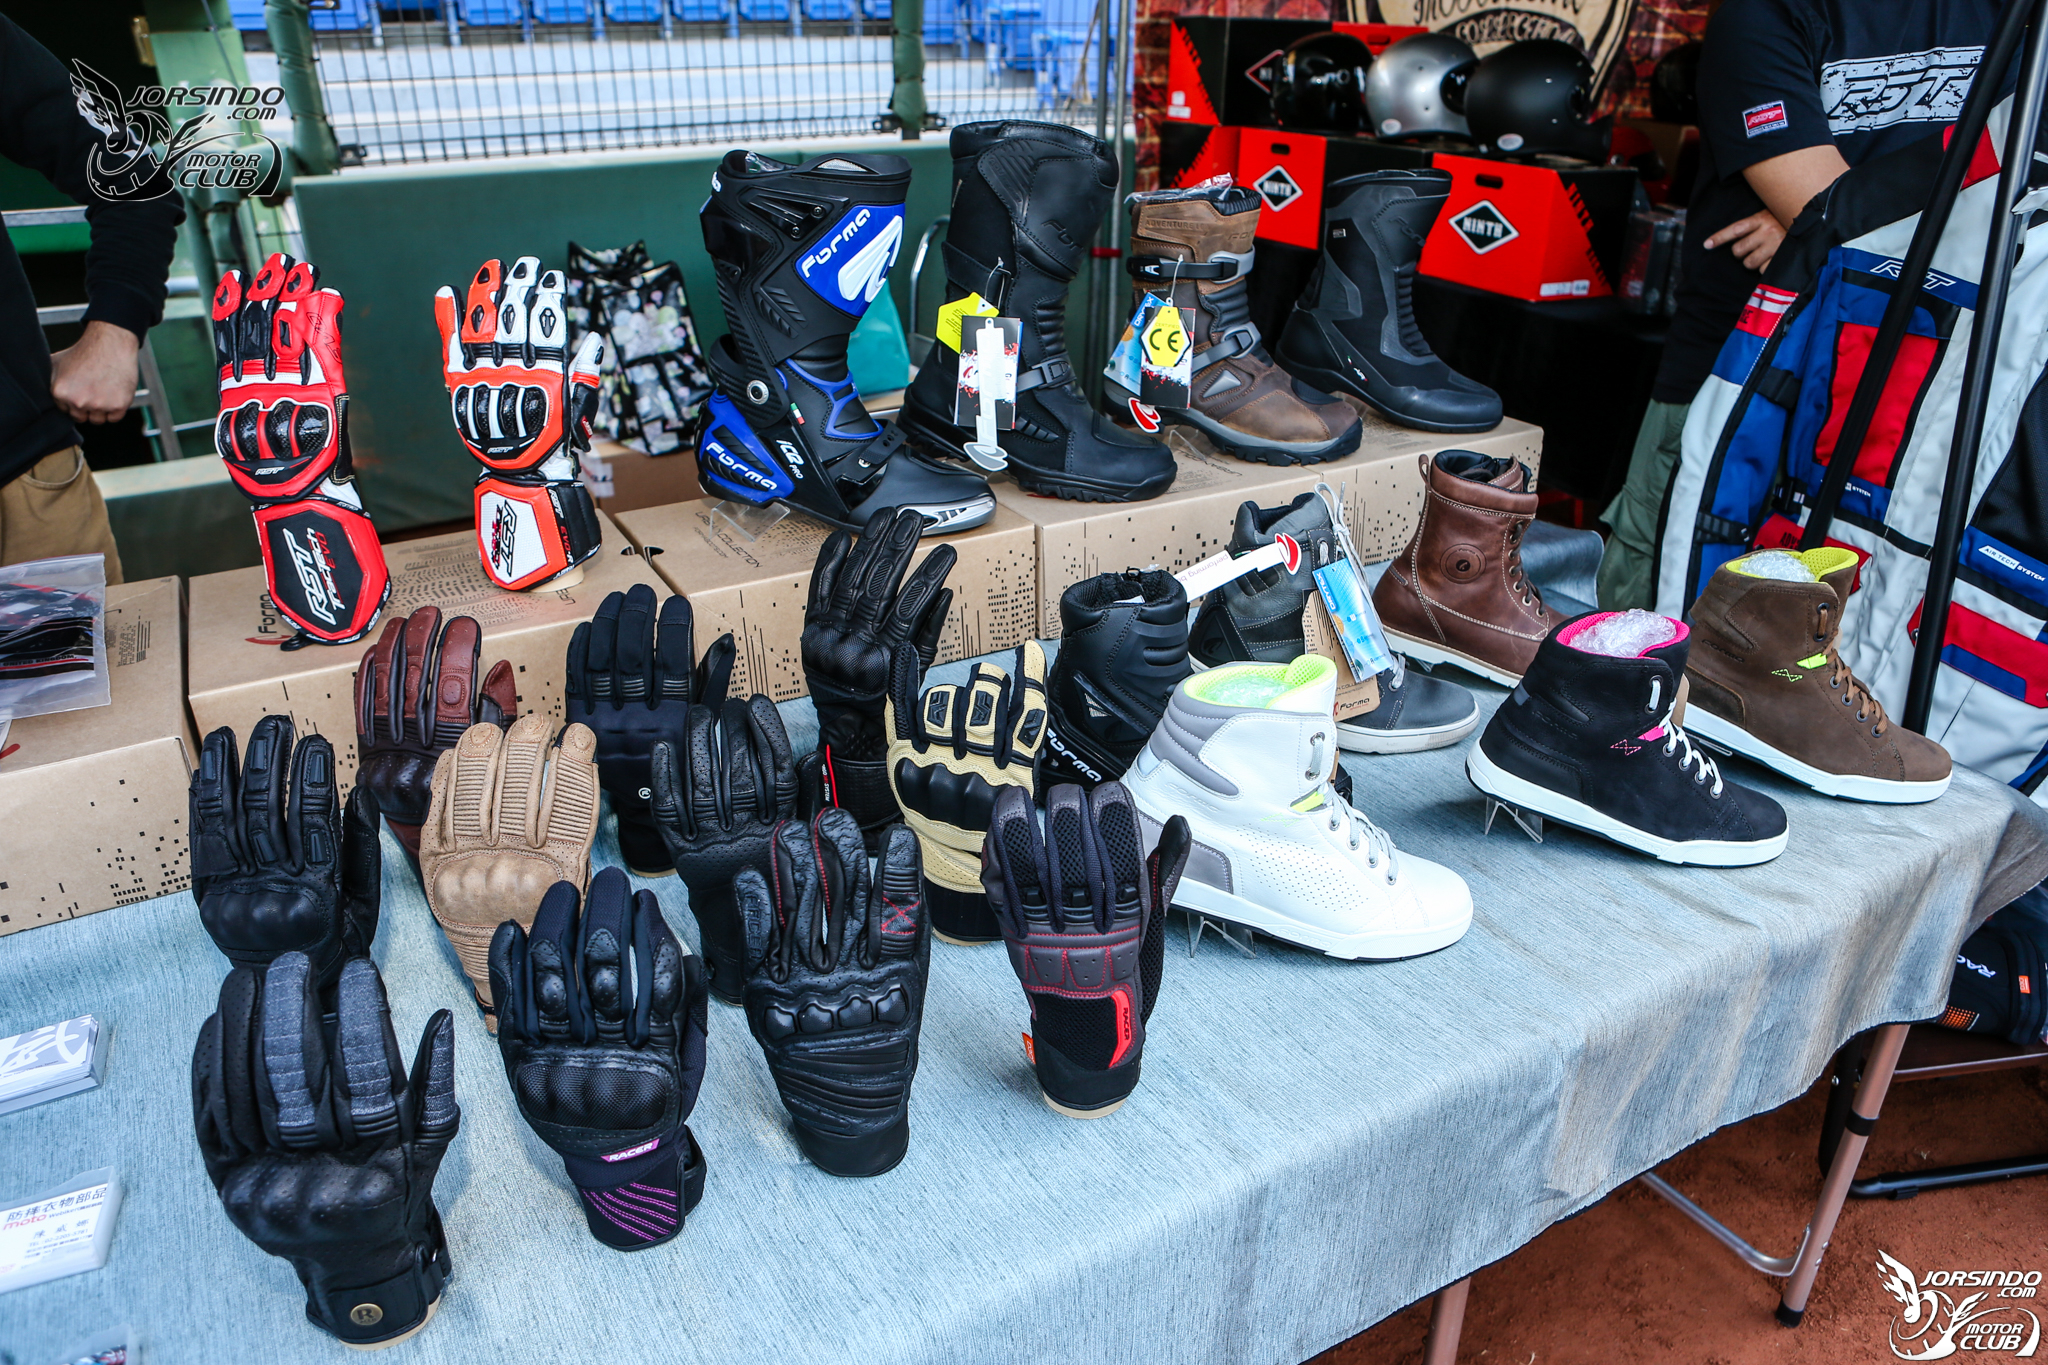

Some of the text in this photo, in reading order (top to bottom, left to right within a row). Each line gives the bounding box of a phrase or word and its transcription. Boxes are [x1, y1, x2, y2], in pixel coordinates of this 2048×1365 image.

[1263, 180, 1293, 197] NINTH
[1145, 220, 1194, 229] ADVENTURE
[1462, 217, 1504, 239] NINTH
[1870, 259, 1957, 290] RT
[1149, 328, 1181, 353] CE
[789, 464, 804, 480] PRO
[501, 500, 518, 578] RST
[282, 528, 337, 626] RST
[1188, 553, 1229, 578] performing
[1984, 547, 2046, 582] AIR TECH SYSTEM
[1122, 1006, 1130, 1041] RACER
[609, 1142, 653, 1161] RACER
[3, 1213, 47, 1230] moto
